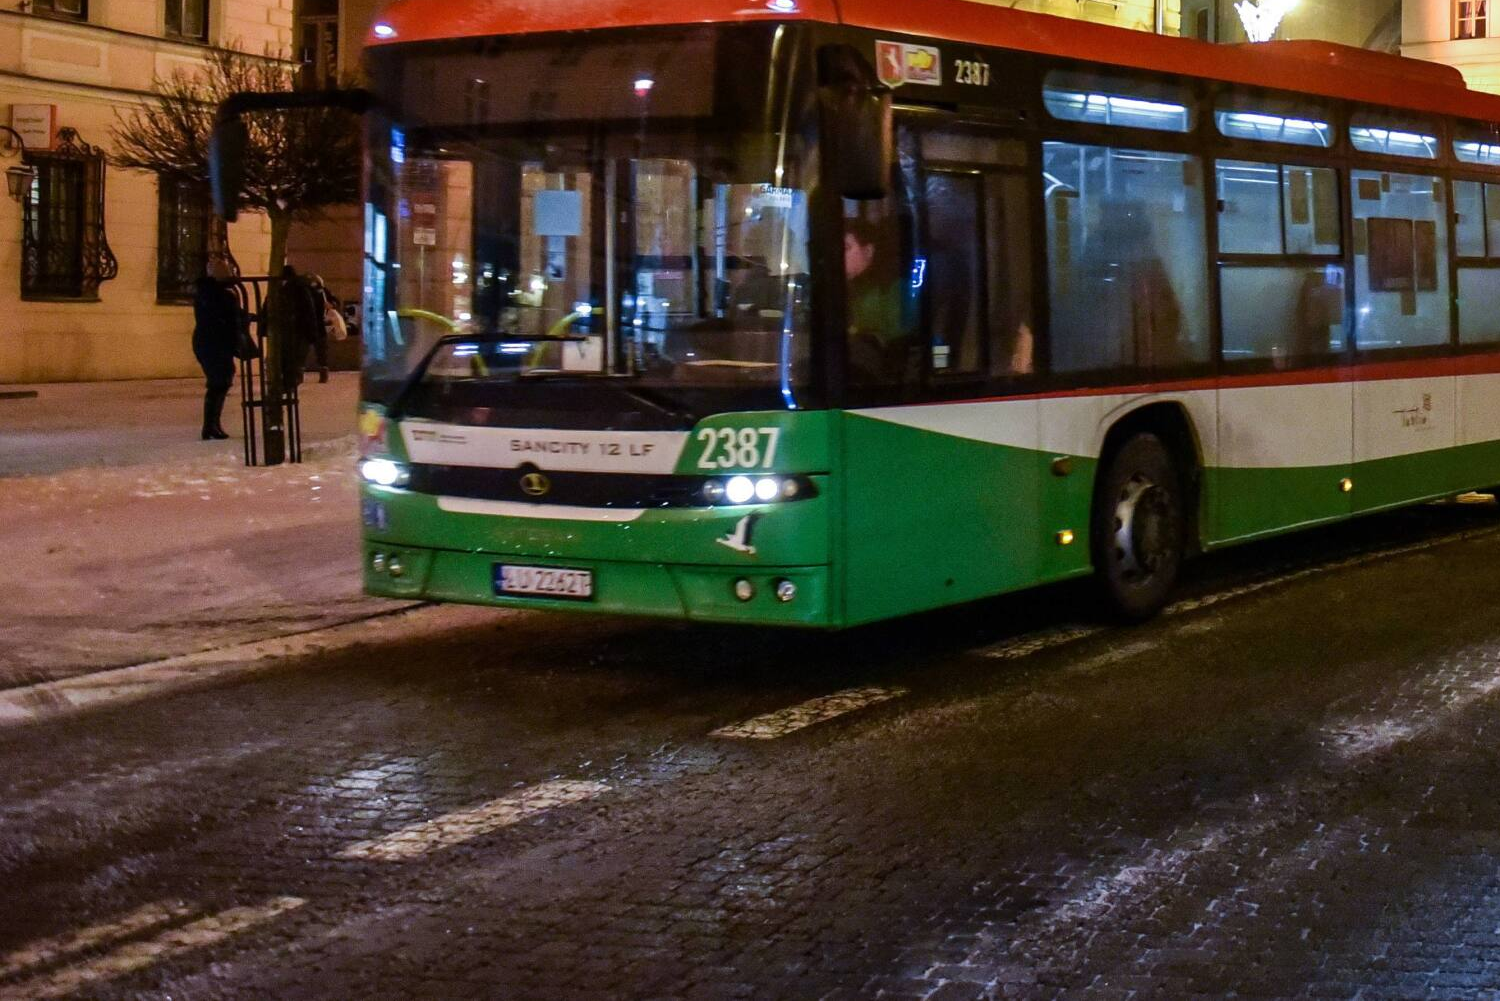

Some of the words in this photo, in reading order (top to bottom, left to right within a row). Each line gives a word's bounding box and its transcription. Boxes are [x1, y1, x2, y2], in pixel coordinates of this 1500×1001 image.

[954, 59, 990, 86] 2387
[510, 439, 590, 454] SANCITY
[599, 443, 621, 456] 12
[629, 444, 655, 456] LF
[697, 427, 781, 468] 2387
